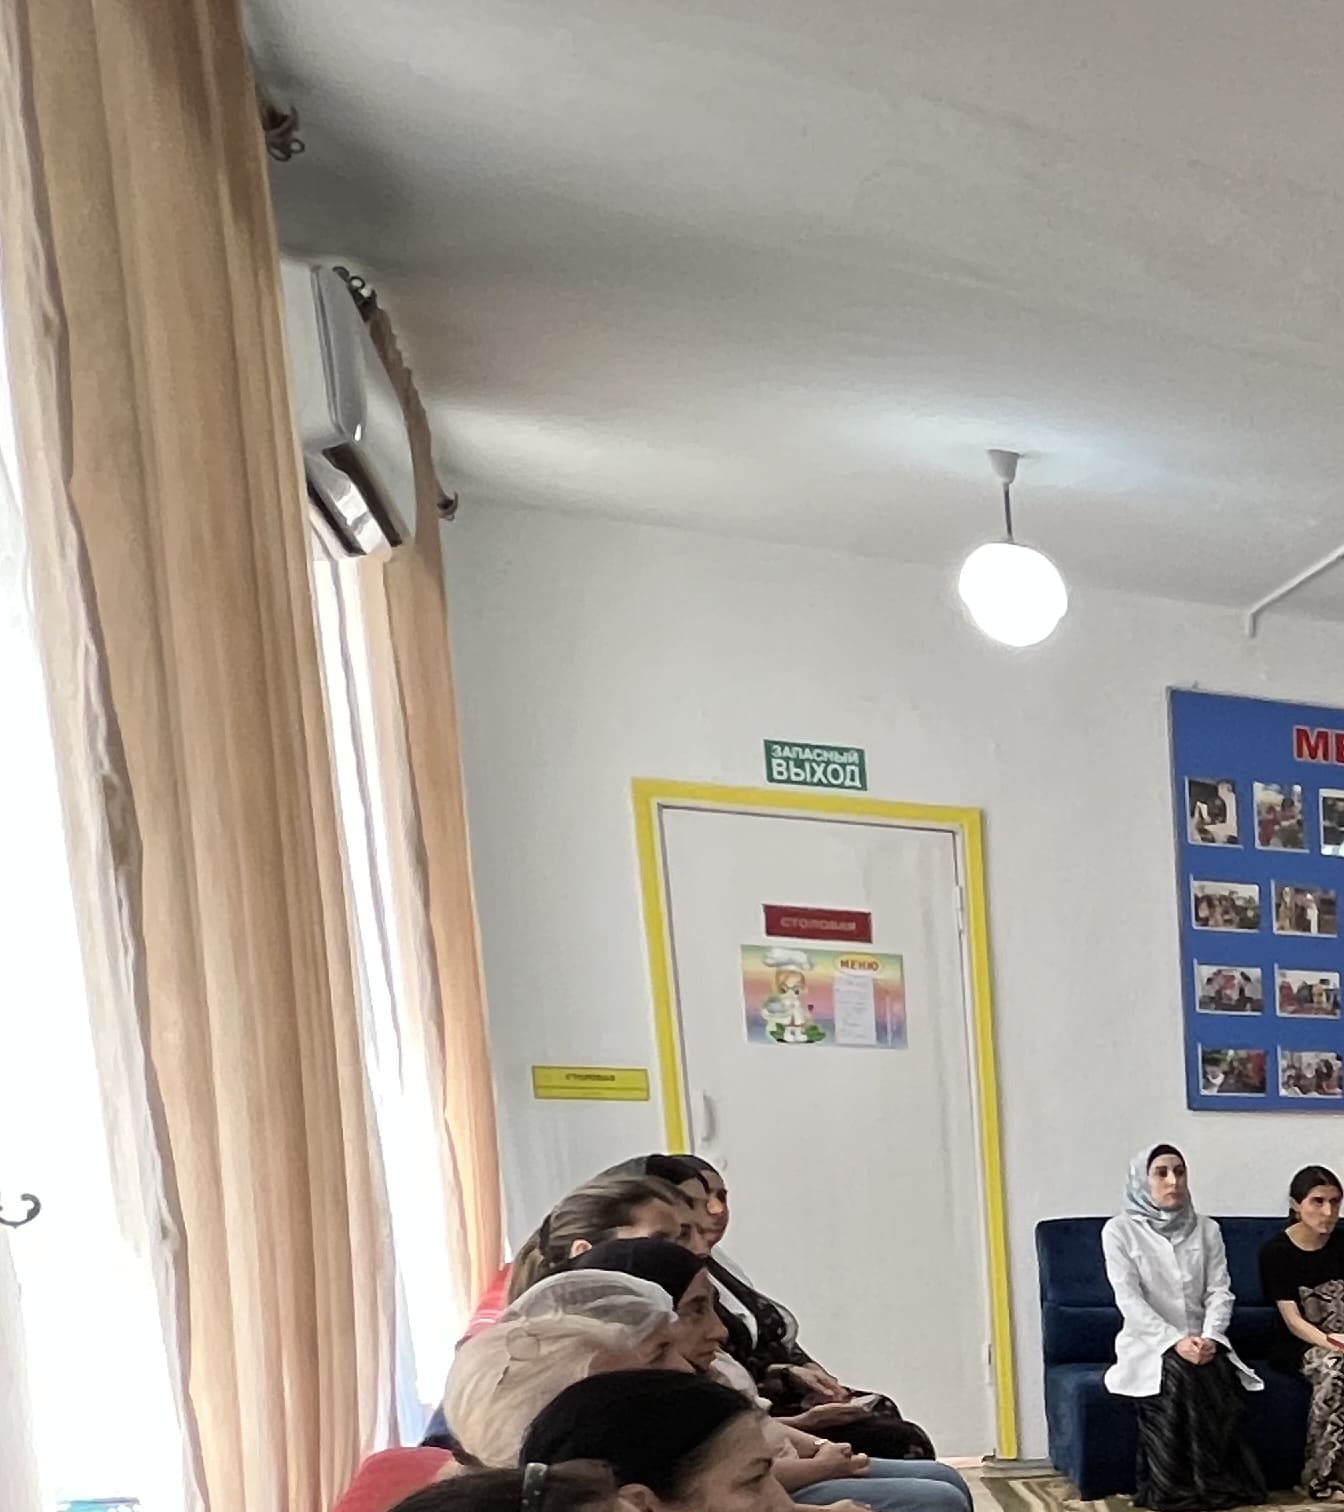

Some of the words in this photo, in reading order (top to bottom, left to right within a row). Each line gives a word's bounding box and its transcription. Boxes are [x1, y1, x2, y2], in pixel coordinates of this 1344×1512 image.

[771, 744, 859, 764] ЗАПАСНЫЙ
[771, 758, 862, 788] ВЫХОД
[840, 959, 879, 972] МЕНЮ
